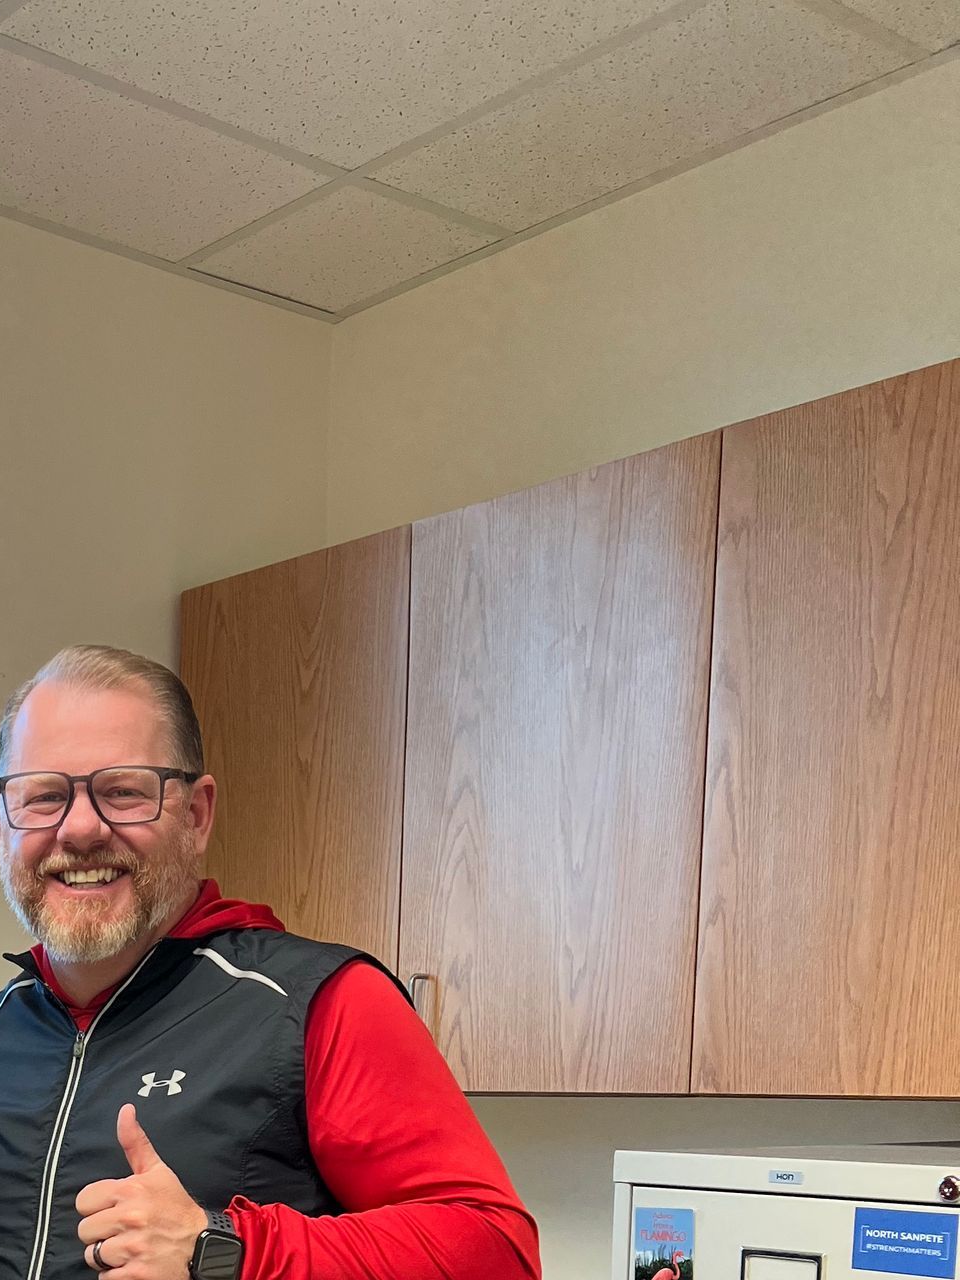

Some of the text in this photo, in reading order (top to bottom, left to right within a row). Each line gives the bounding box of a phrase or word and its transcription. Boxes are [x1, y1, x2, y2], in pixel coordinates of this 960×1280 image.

[865, 1229, 944, 1244] NORTH SANPETE
[865, 1243, 942, 1257] #STRENGTHMATTERS
